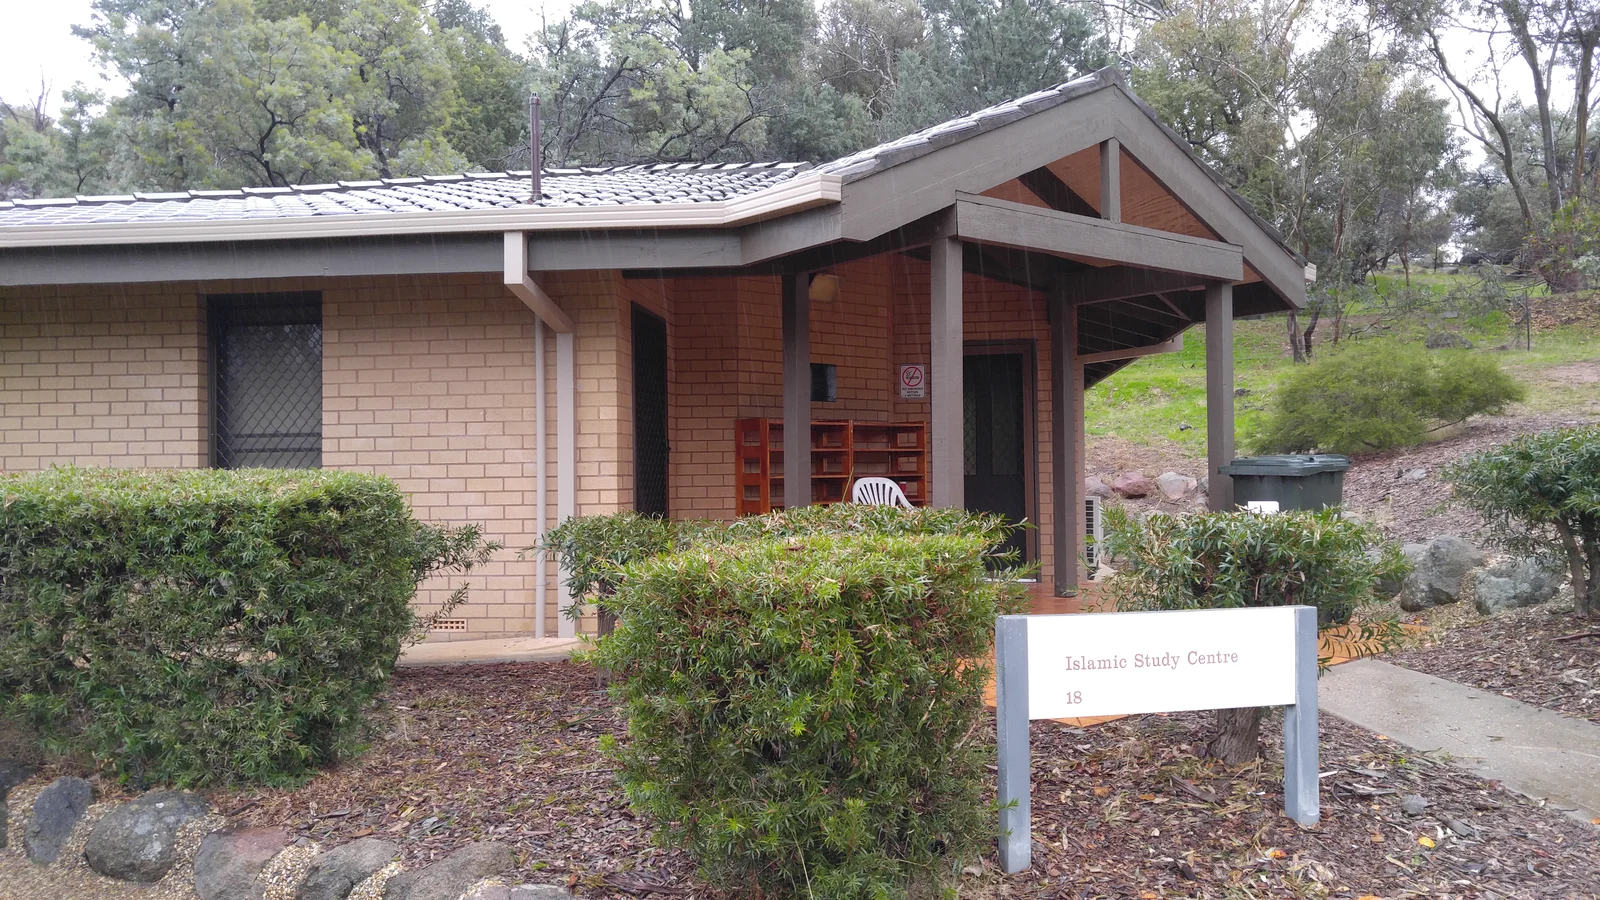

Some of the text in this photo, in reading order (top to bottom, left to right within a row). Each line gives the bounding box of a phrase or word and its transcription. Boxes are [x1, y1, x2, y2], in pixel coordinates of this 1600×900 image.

[1065, 650, 1239, 671] Islamic Study Centre
[1066, 690, 1083, 705] 18
